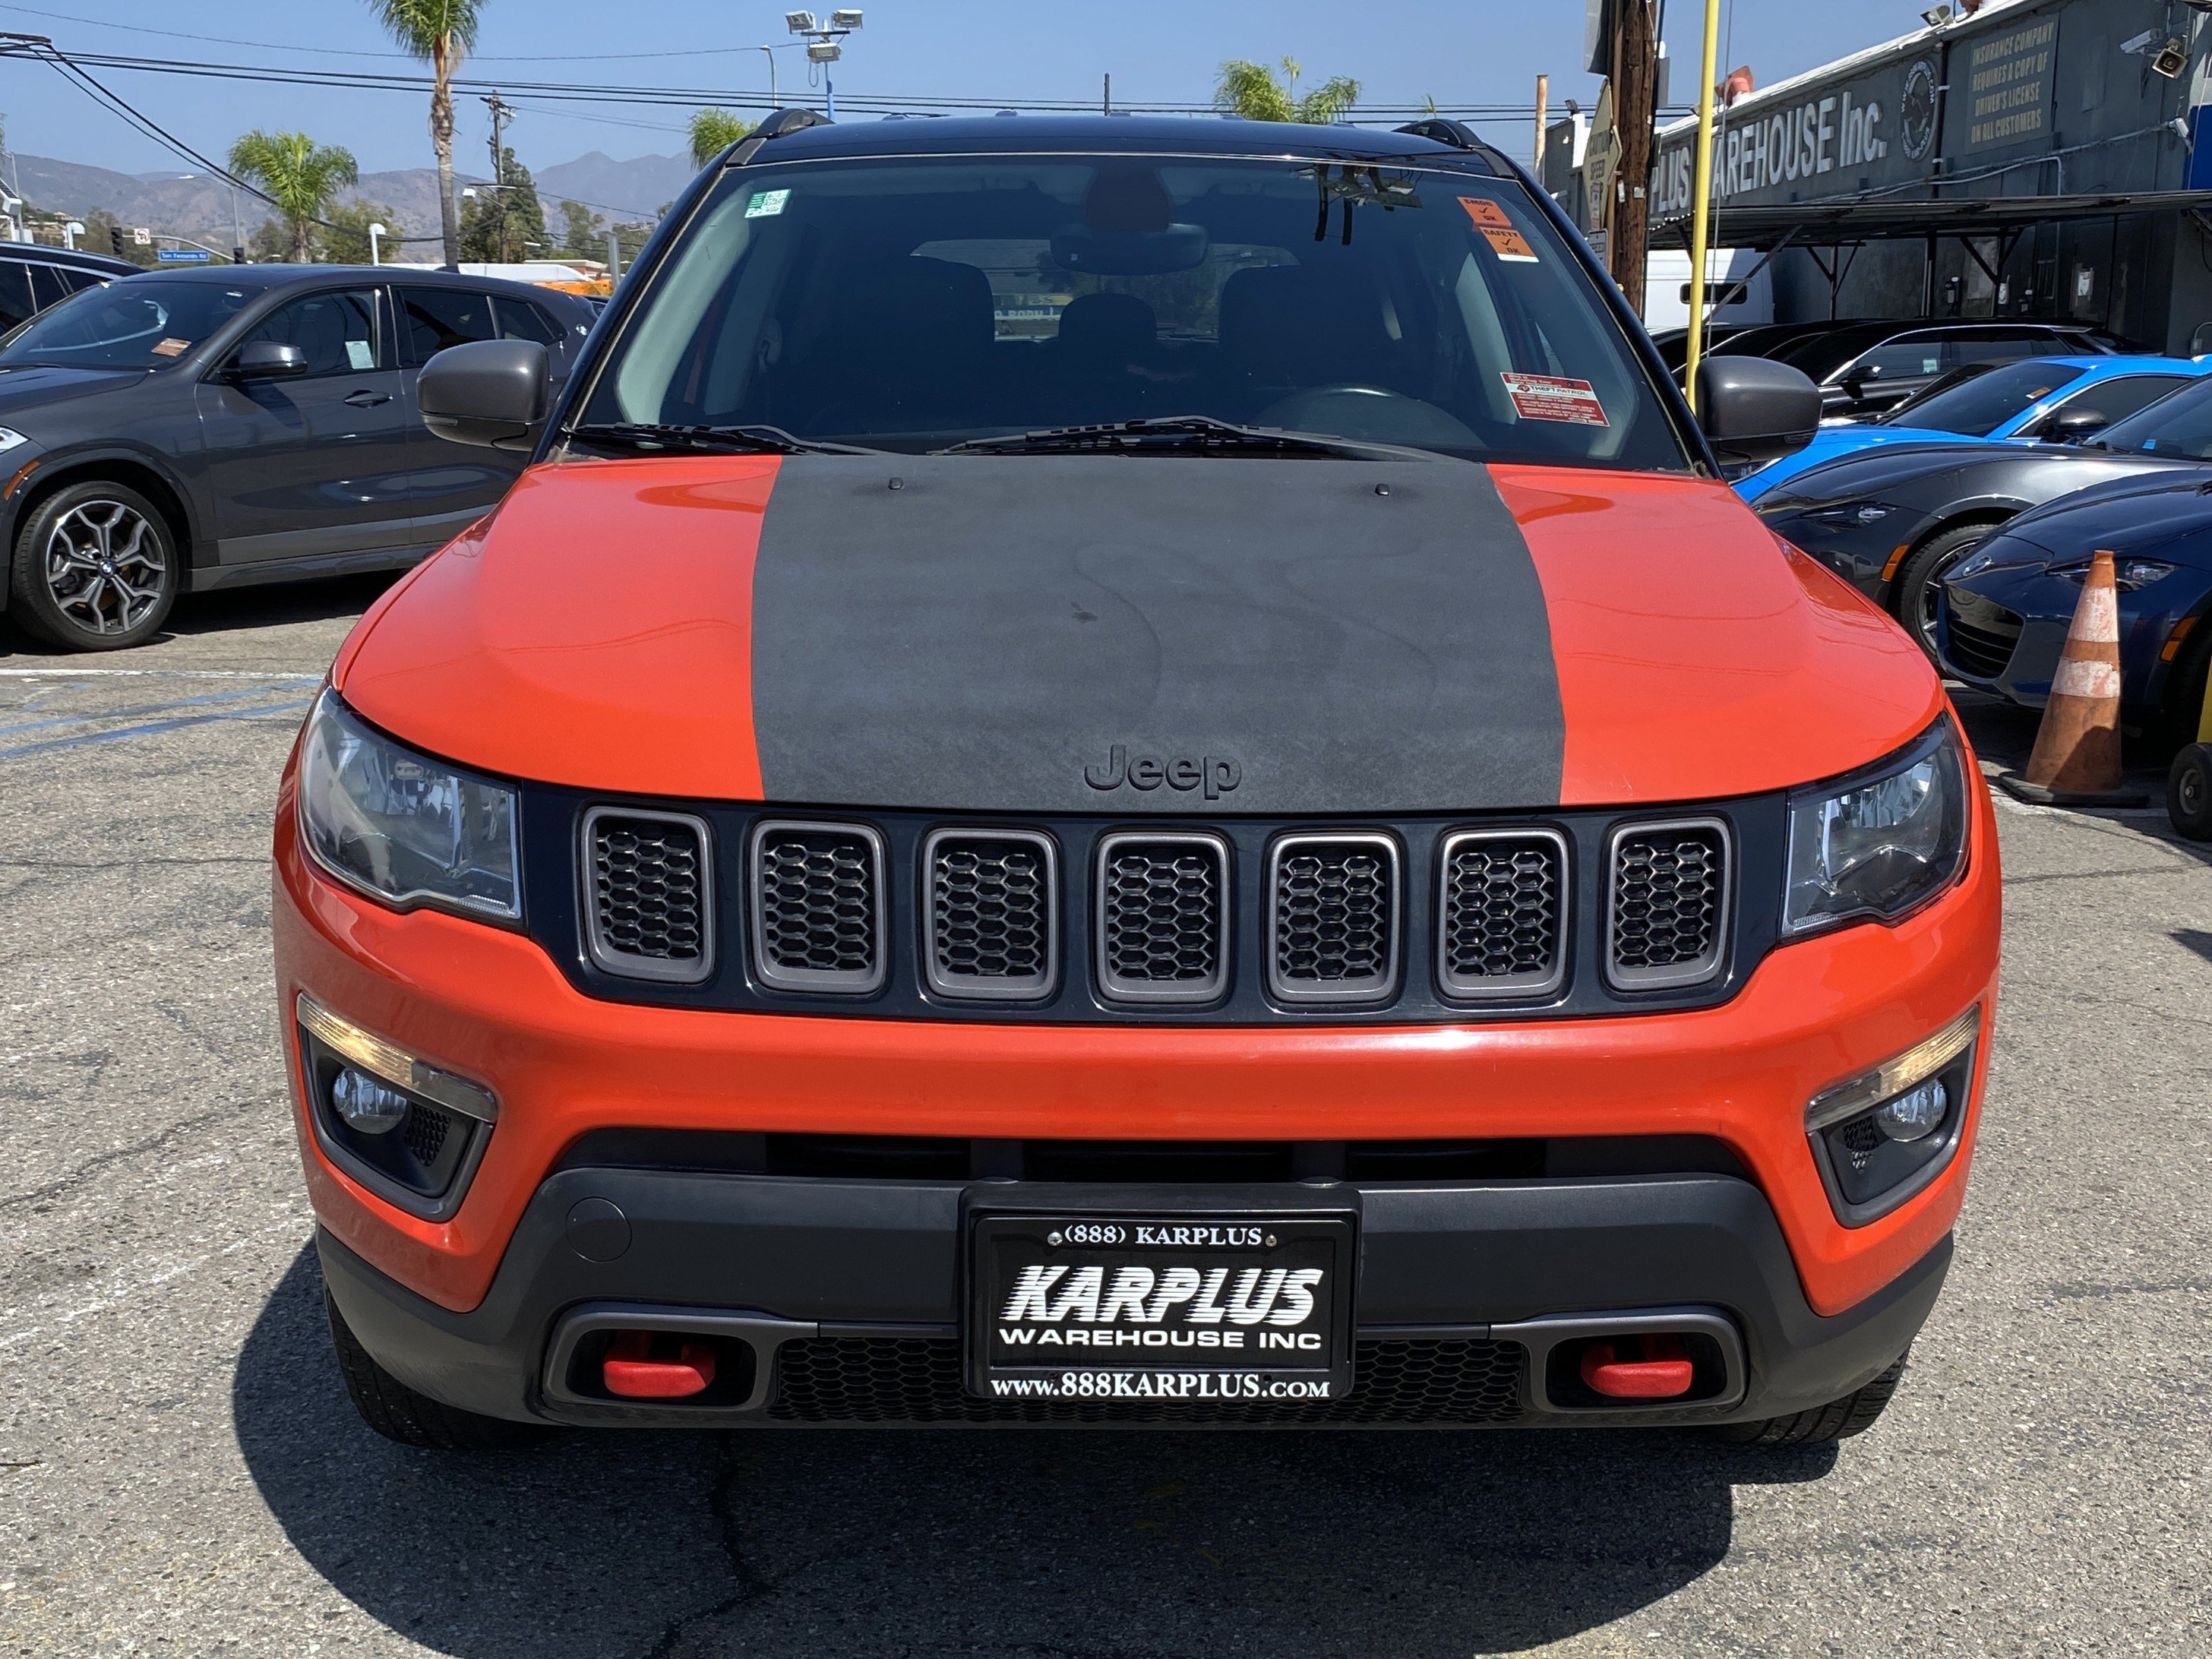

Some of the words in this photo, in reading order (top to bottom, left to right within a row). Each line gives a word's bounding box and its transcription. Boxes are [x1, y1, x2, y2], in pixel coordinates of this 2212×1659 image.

[1973, 36, 2013, 66] INSURANCE
[2014, 22, 2054, 53] COMPANY
[1973, 64, 2006, 92] REQUIRES
[2008, 62, 2012, 81] A
[2014, 55, 2037, 79] COPY
[2037, 51, 2048, 72] OF
[1975, 90, 2007, 117] DRIVER'S
[2008, 81, 2040, 108] LICENSE
[1711, 96, 1837, 199] AREHOUSE
[1840, 91, 1887, 167] Inc.
[1971, 125, 1981, 144] ON
[1982, 122, 1994, 141] ALL
[1995, 108, 2042, 138] CUSTOMERS
[1483, 229, 1518, 238] SAFETY
[1084, 744, 1242, 800] Jeep
[1064, 1224, 1126, 1244] (888)
[1135, 1225, 1262, 1247] KARPLUS
[998, 1266, 1324, 1326] KARPLUS
[998, 1328, 1245, 1348] WAREHOUSE
[1259, 1332, 1322, 1350] INC
